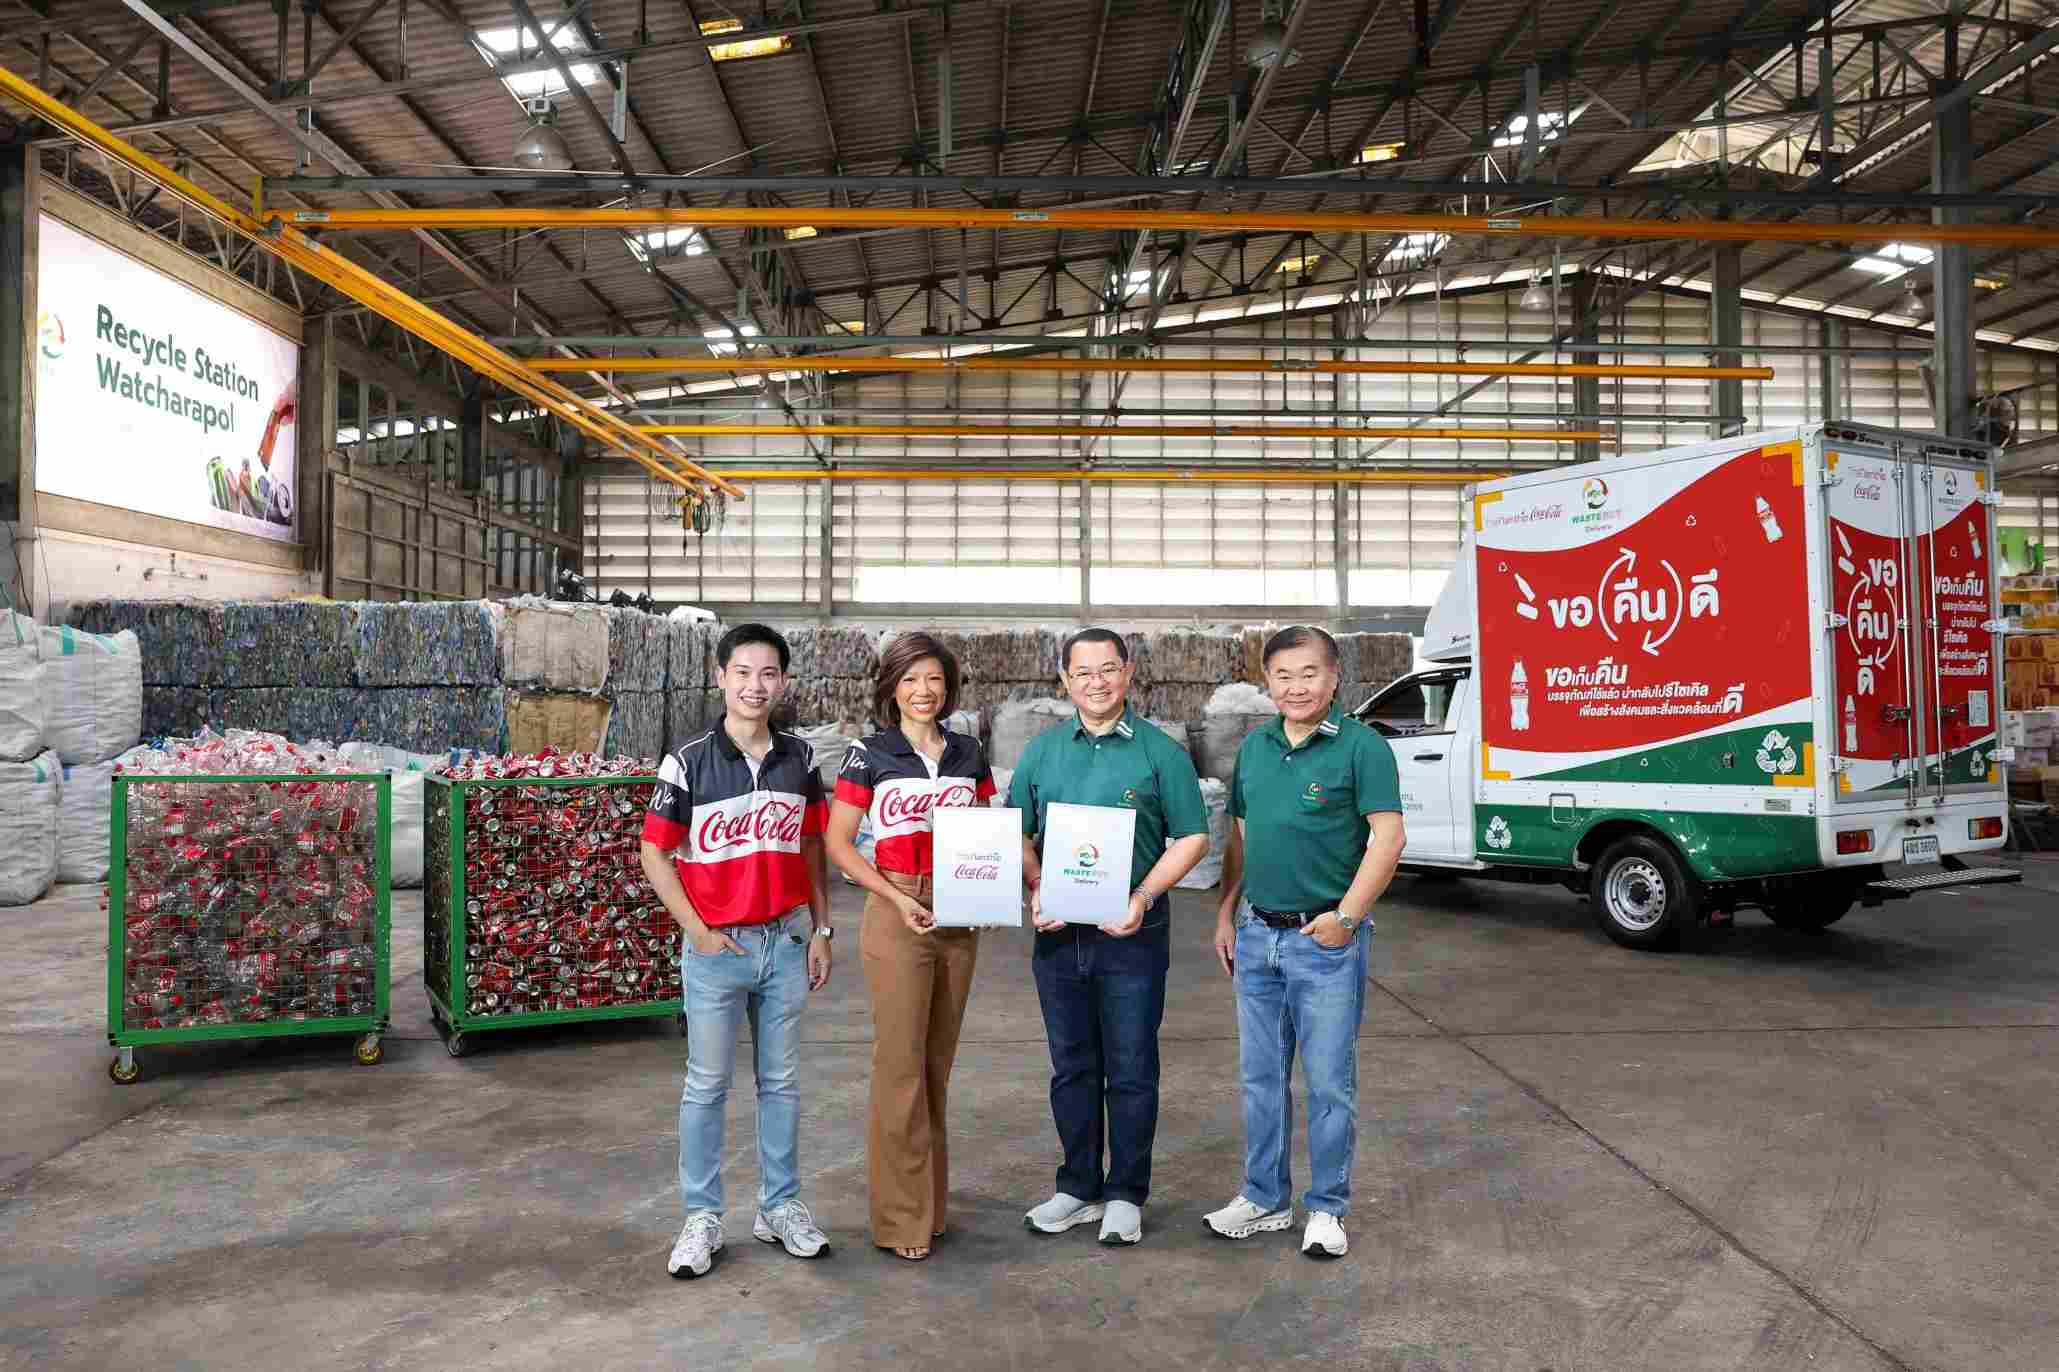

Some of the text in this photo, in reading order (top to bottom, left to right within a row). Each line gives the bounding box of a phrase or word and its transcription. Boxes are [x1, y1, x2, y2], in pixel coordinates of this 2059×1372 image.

[97, 304, 259, 402] Recycle Station
[96, 353, 234, 433] Watcharapol
[1868, 558, 1897, 588] ขอ
[1547, 567, 1720, 630] ขอ คืน ดี
[1856, 598, 1889, 640] คืน
[1545, 656, 1629, 689] ขอเก็บคืน
[1857, 654, 1874, 696] ดี
[699, 801, 800, 853] Coca-Cola
